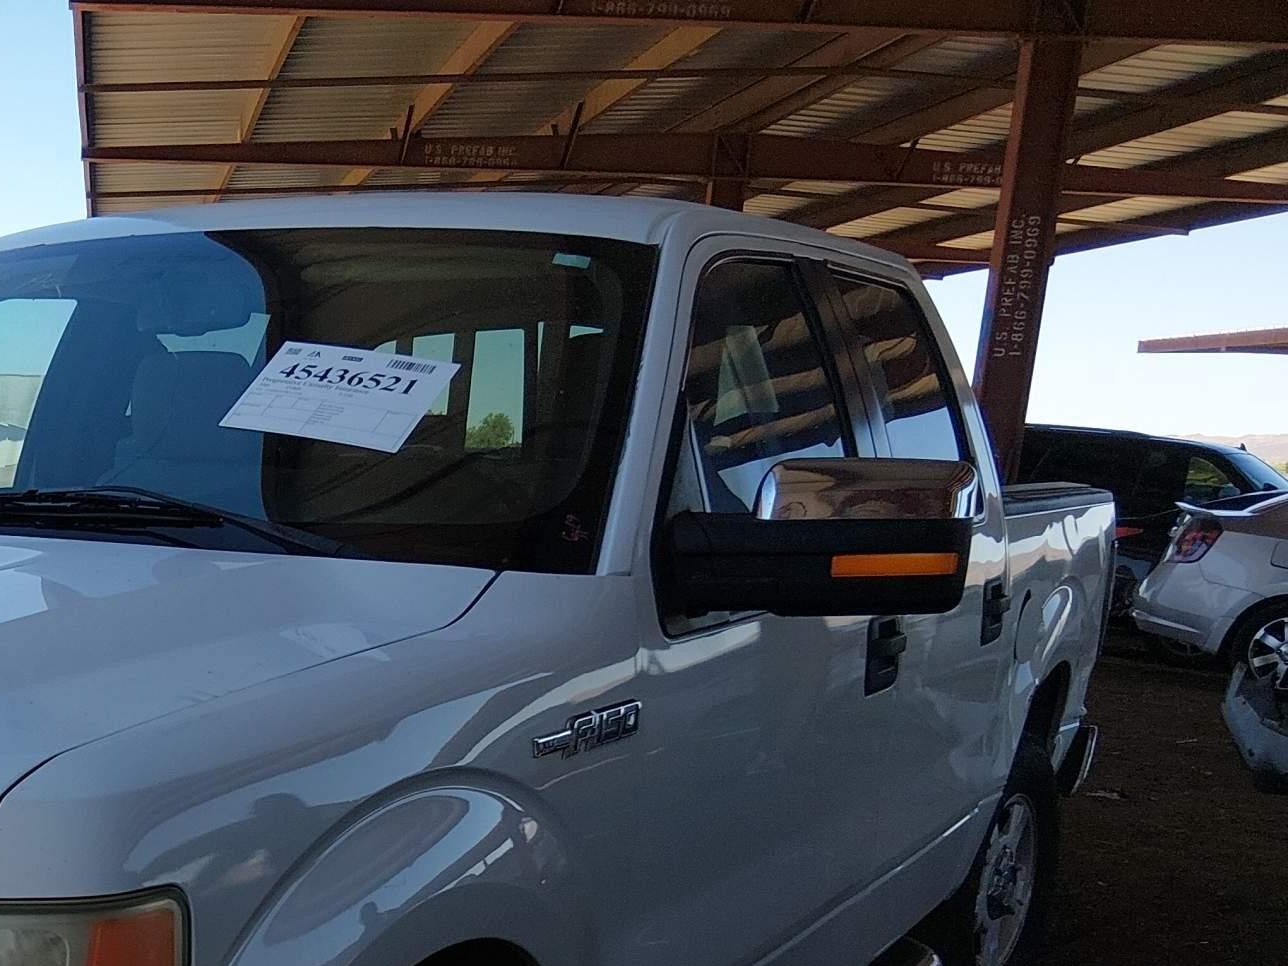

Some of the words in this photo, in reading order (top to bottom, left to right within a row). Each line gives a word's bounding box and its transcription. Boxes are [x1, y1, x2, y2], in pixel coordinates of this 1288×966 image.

[1009, 214, 1026, 245] INC.
[999, 254, 1020, 317] PREFAB
[1008, 216, 1041, 356] 1-866-799-0969
[280, 362, 419, 395] 45436521
